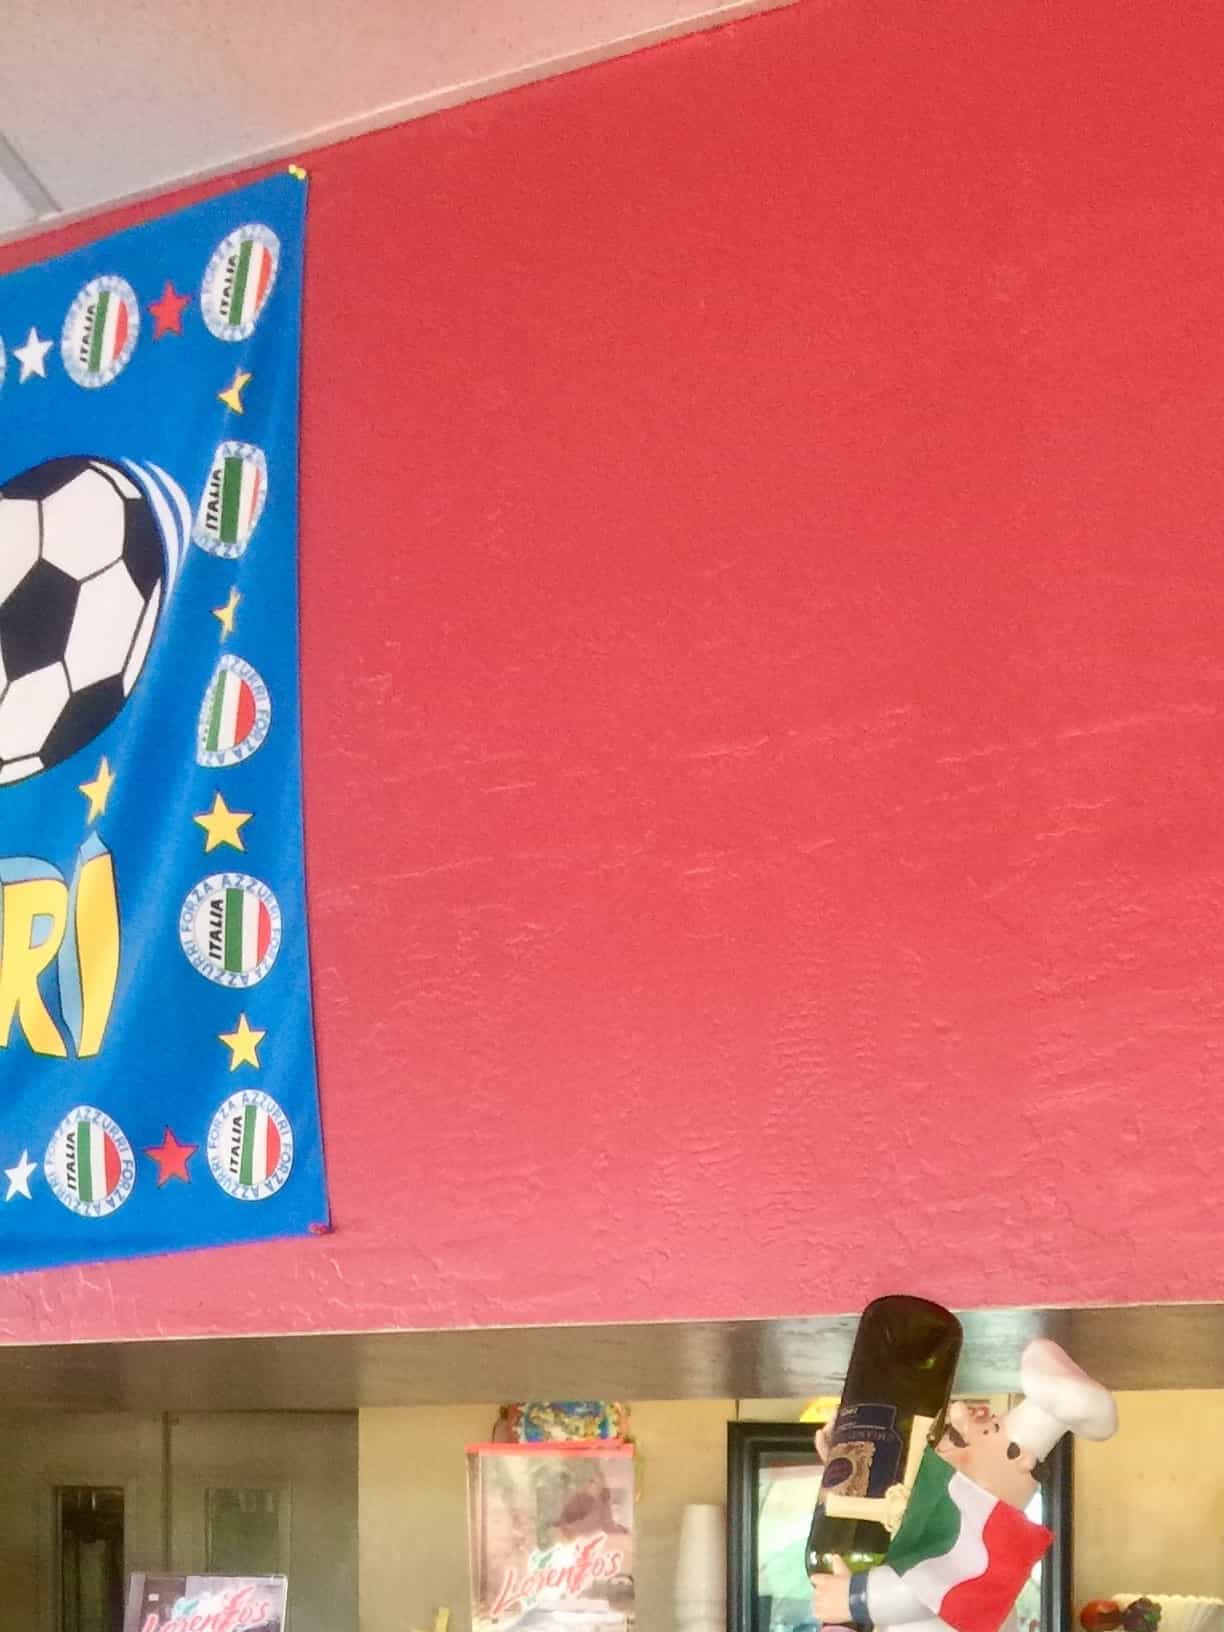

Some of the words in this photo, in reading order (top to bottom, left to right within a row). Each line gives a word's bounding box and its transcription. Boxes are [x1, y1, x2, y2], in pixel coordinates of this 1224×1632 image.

[219, 253, 238, 316] ITALIA
[79, 303, 96, 363] ITALIA
[205, 467, 223, 531] ITALIA
[181, 881, 214, 933] FORZA
[208, 898, 225, 961] ITALIA
[65, 1131, 78, 1191] ITALIA
[229, 1115, 244, 1174] ITALIA
